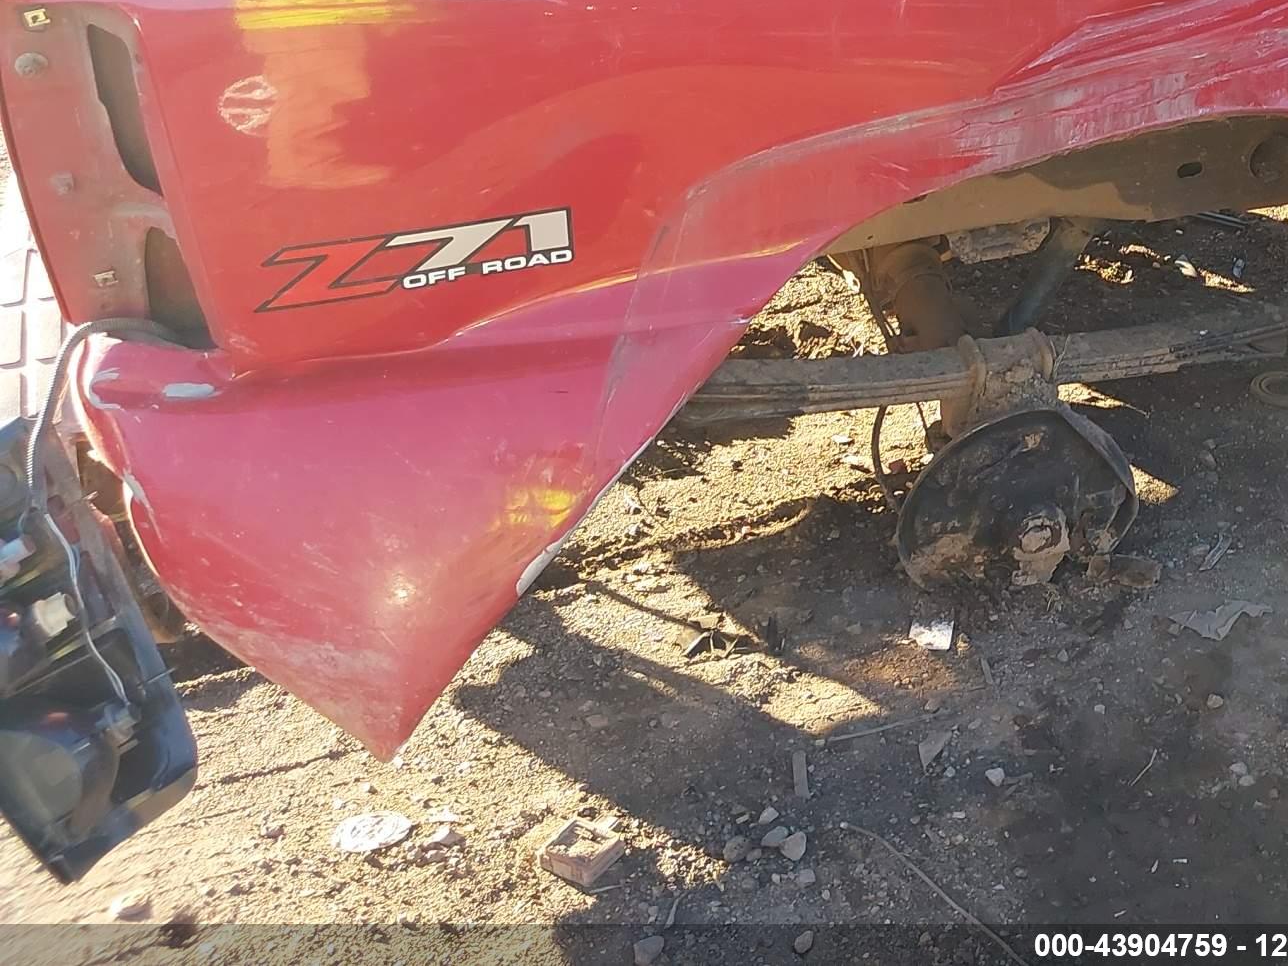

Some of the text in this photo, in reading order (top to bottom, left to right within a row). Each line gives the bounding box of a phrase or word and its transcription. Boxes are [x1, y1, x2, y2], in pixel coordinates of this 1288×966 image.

[254, 207, 572, 313] Z71
[403, 249, 573, 290] OFF ROAD
